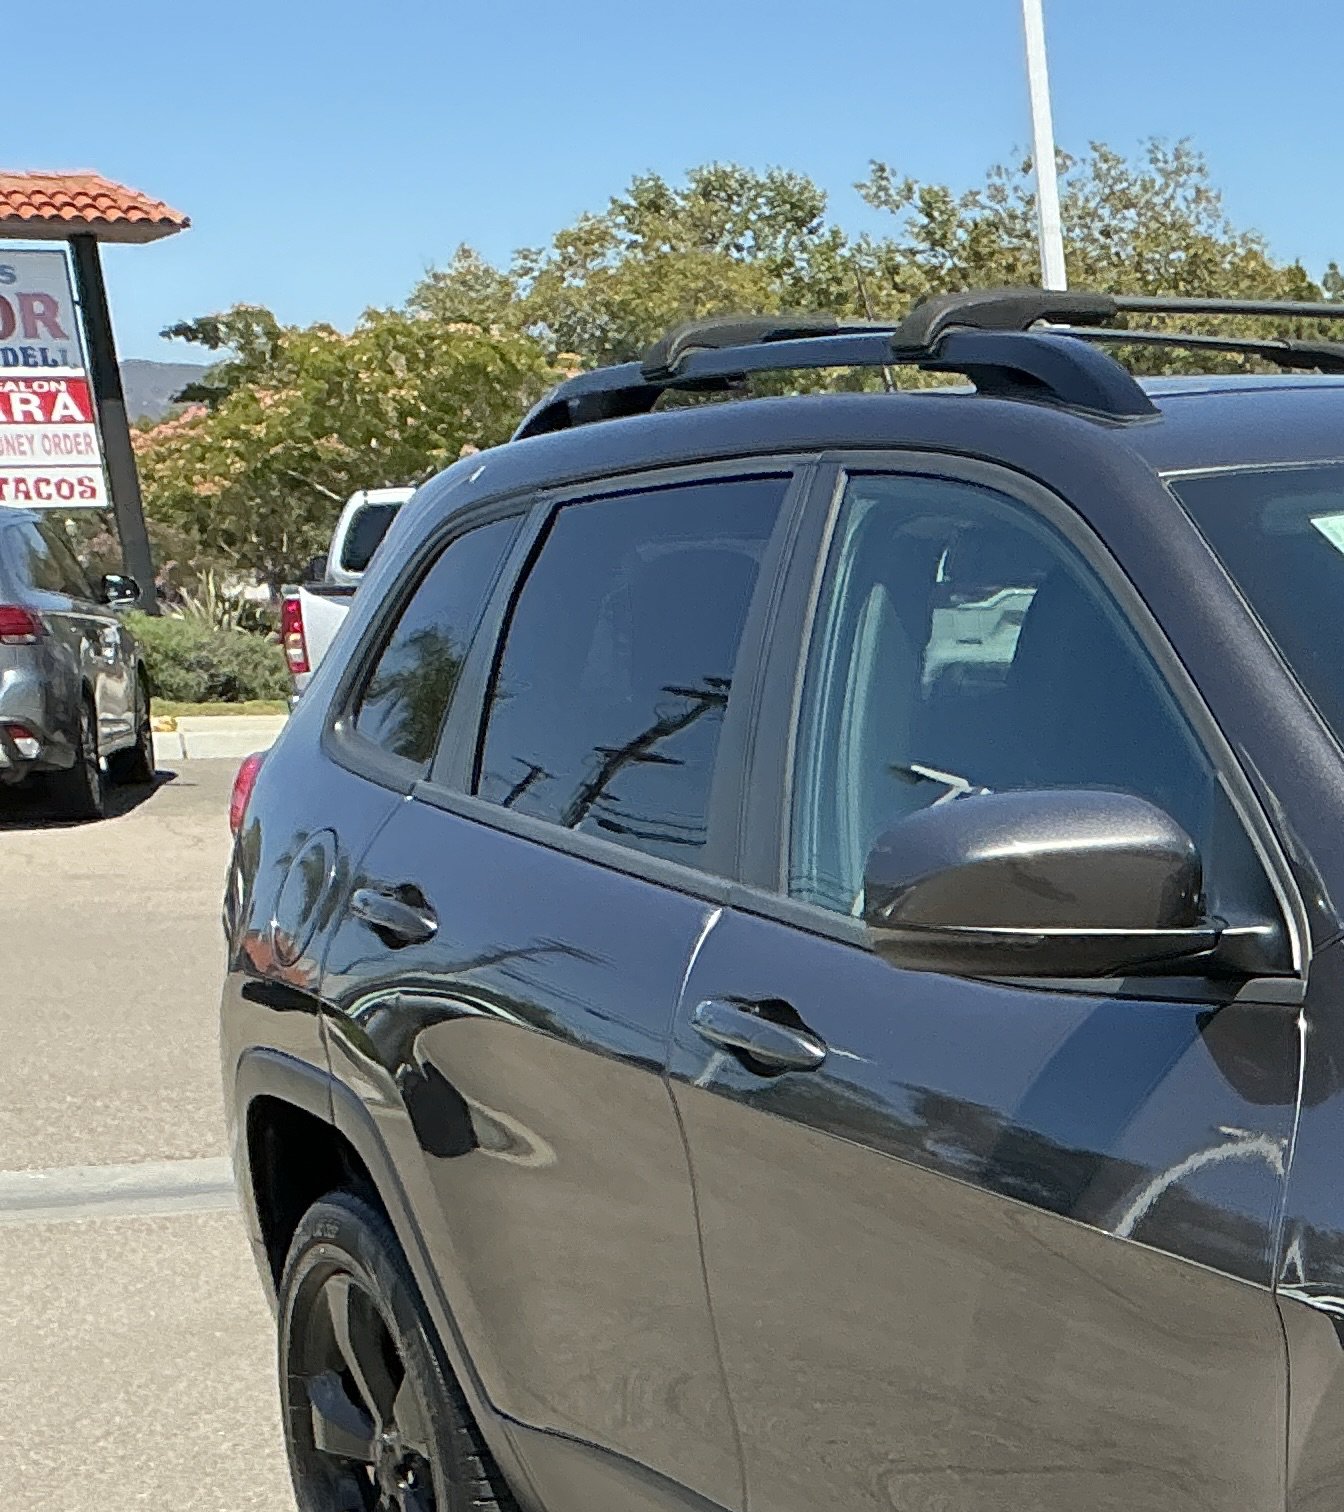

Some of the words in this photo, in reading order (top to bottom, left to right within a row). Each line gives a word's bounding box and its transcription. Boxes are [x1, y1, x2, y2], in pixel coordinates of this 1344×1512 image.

[0, 380, 67, 393] ALON
[0, 392, 85, 422] RA
[0, 432, 35, 456] NEY
[41, 432, 95, 456] ORDER
[0, 475, 97, 501] TACOS
